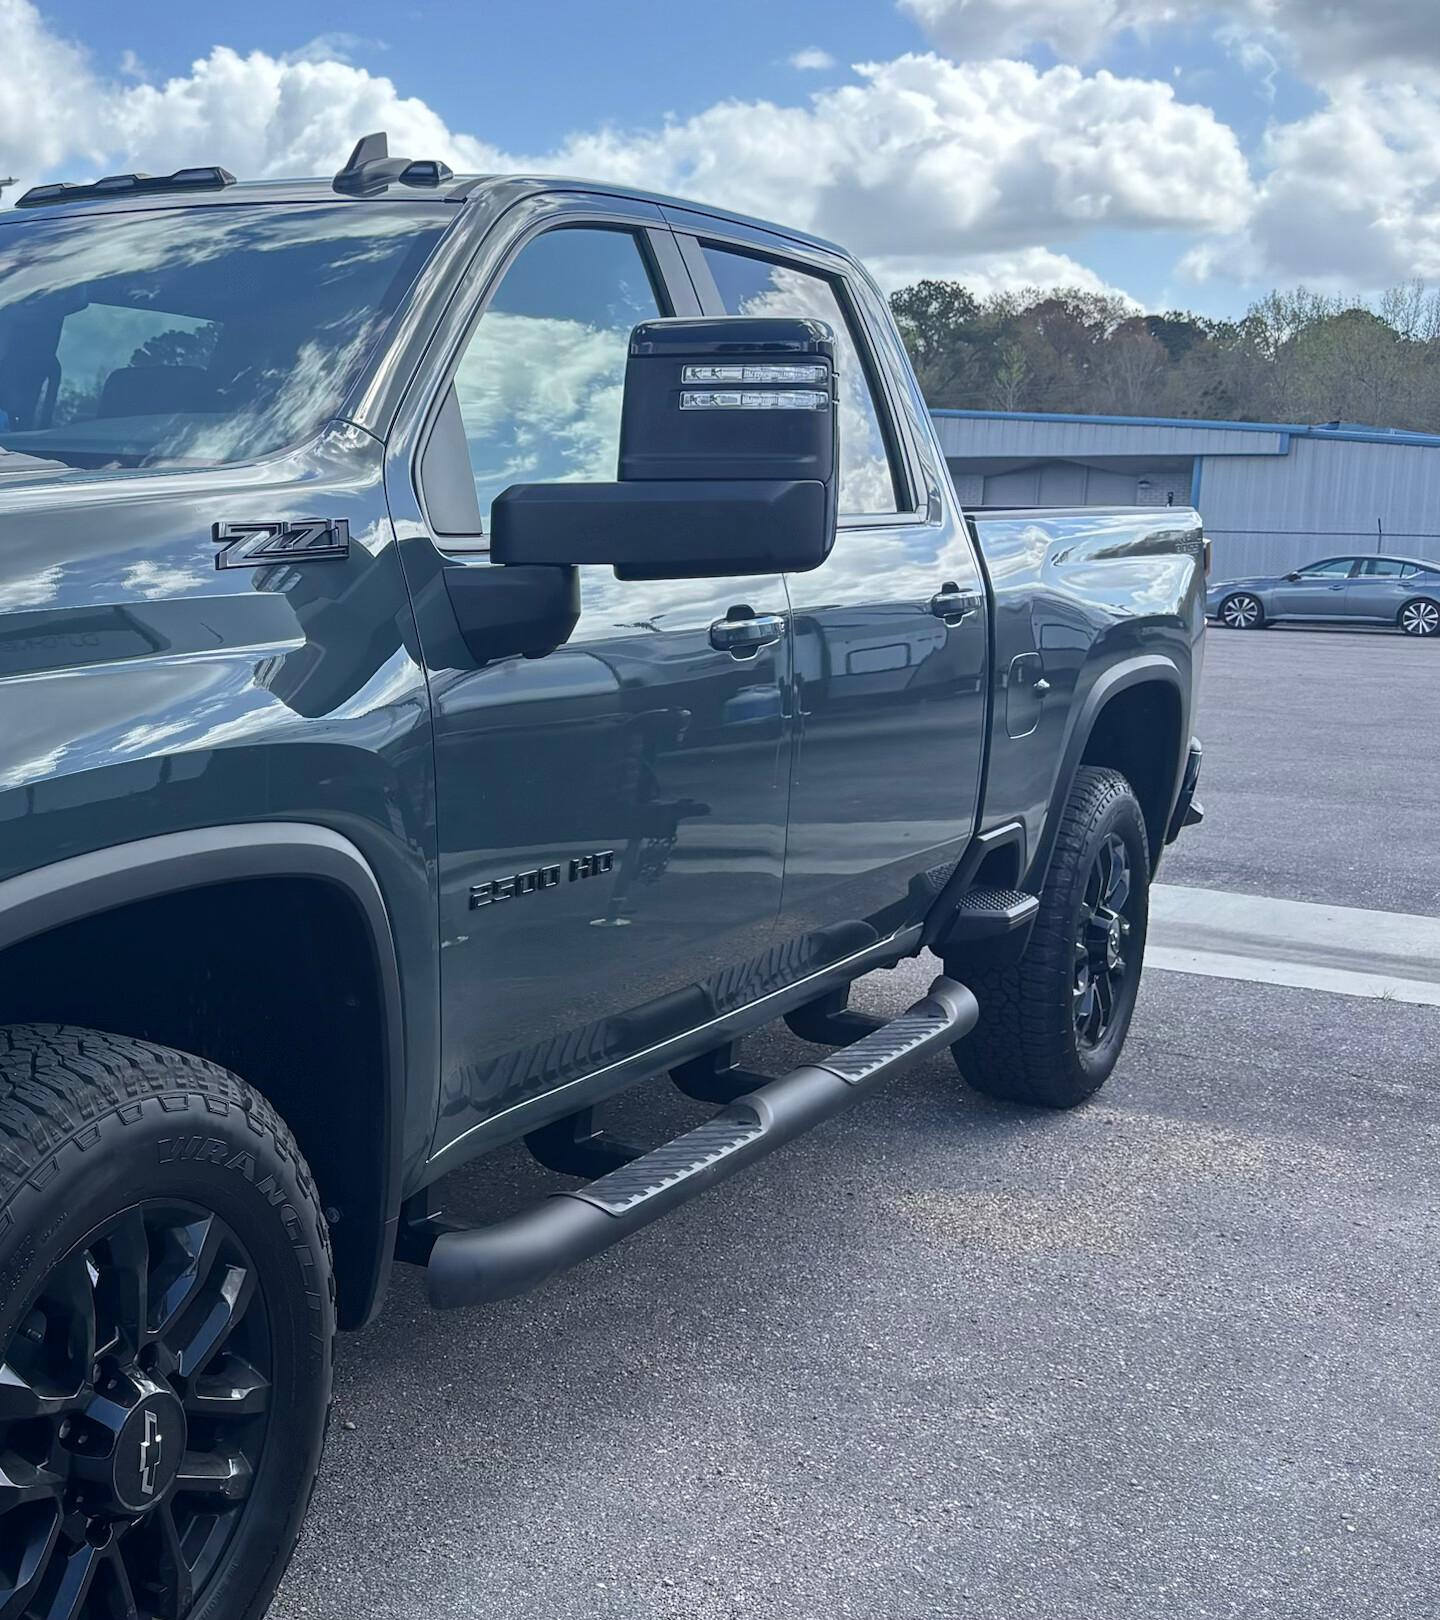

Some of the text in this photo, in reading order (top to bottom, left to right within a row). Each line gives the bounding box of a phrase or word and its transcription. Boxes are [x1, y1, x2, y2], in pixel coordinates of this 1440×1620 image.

[469, 850, 614, 911] 2500 HD
[157, 1134, 325, 1374] WRANGL
